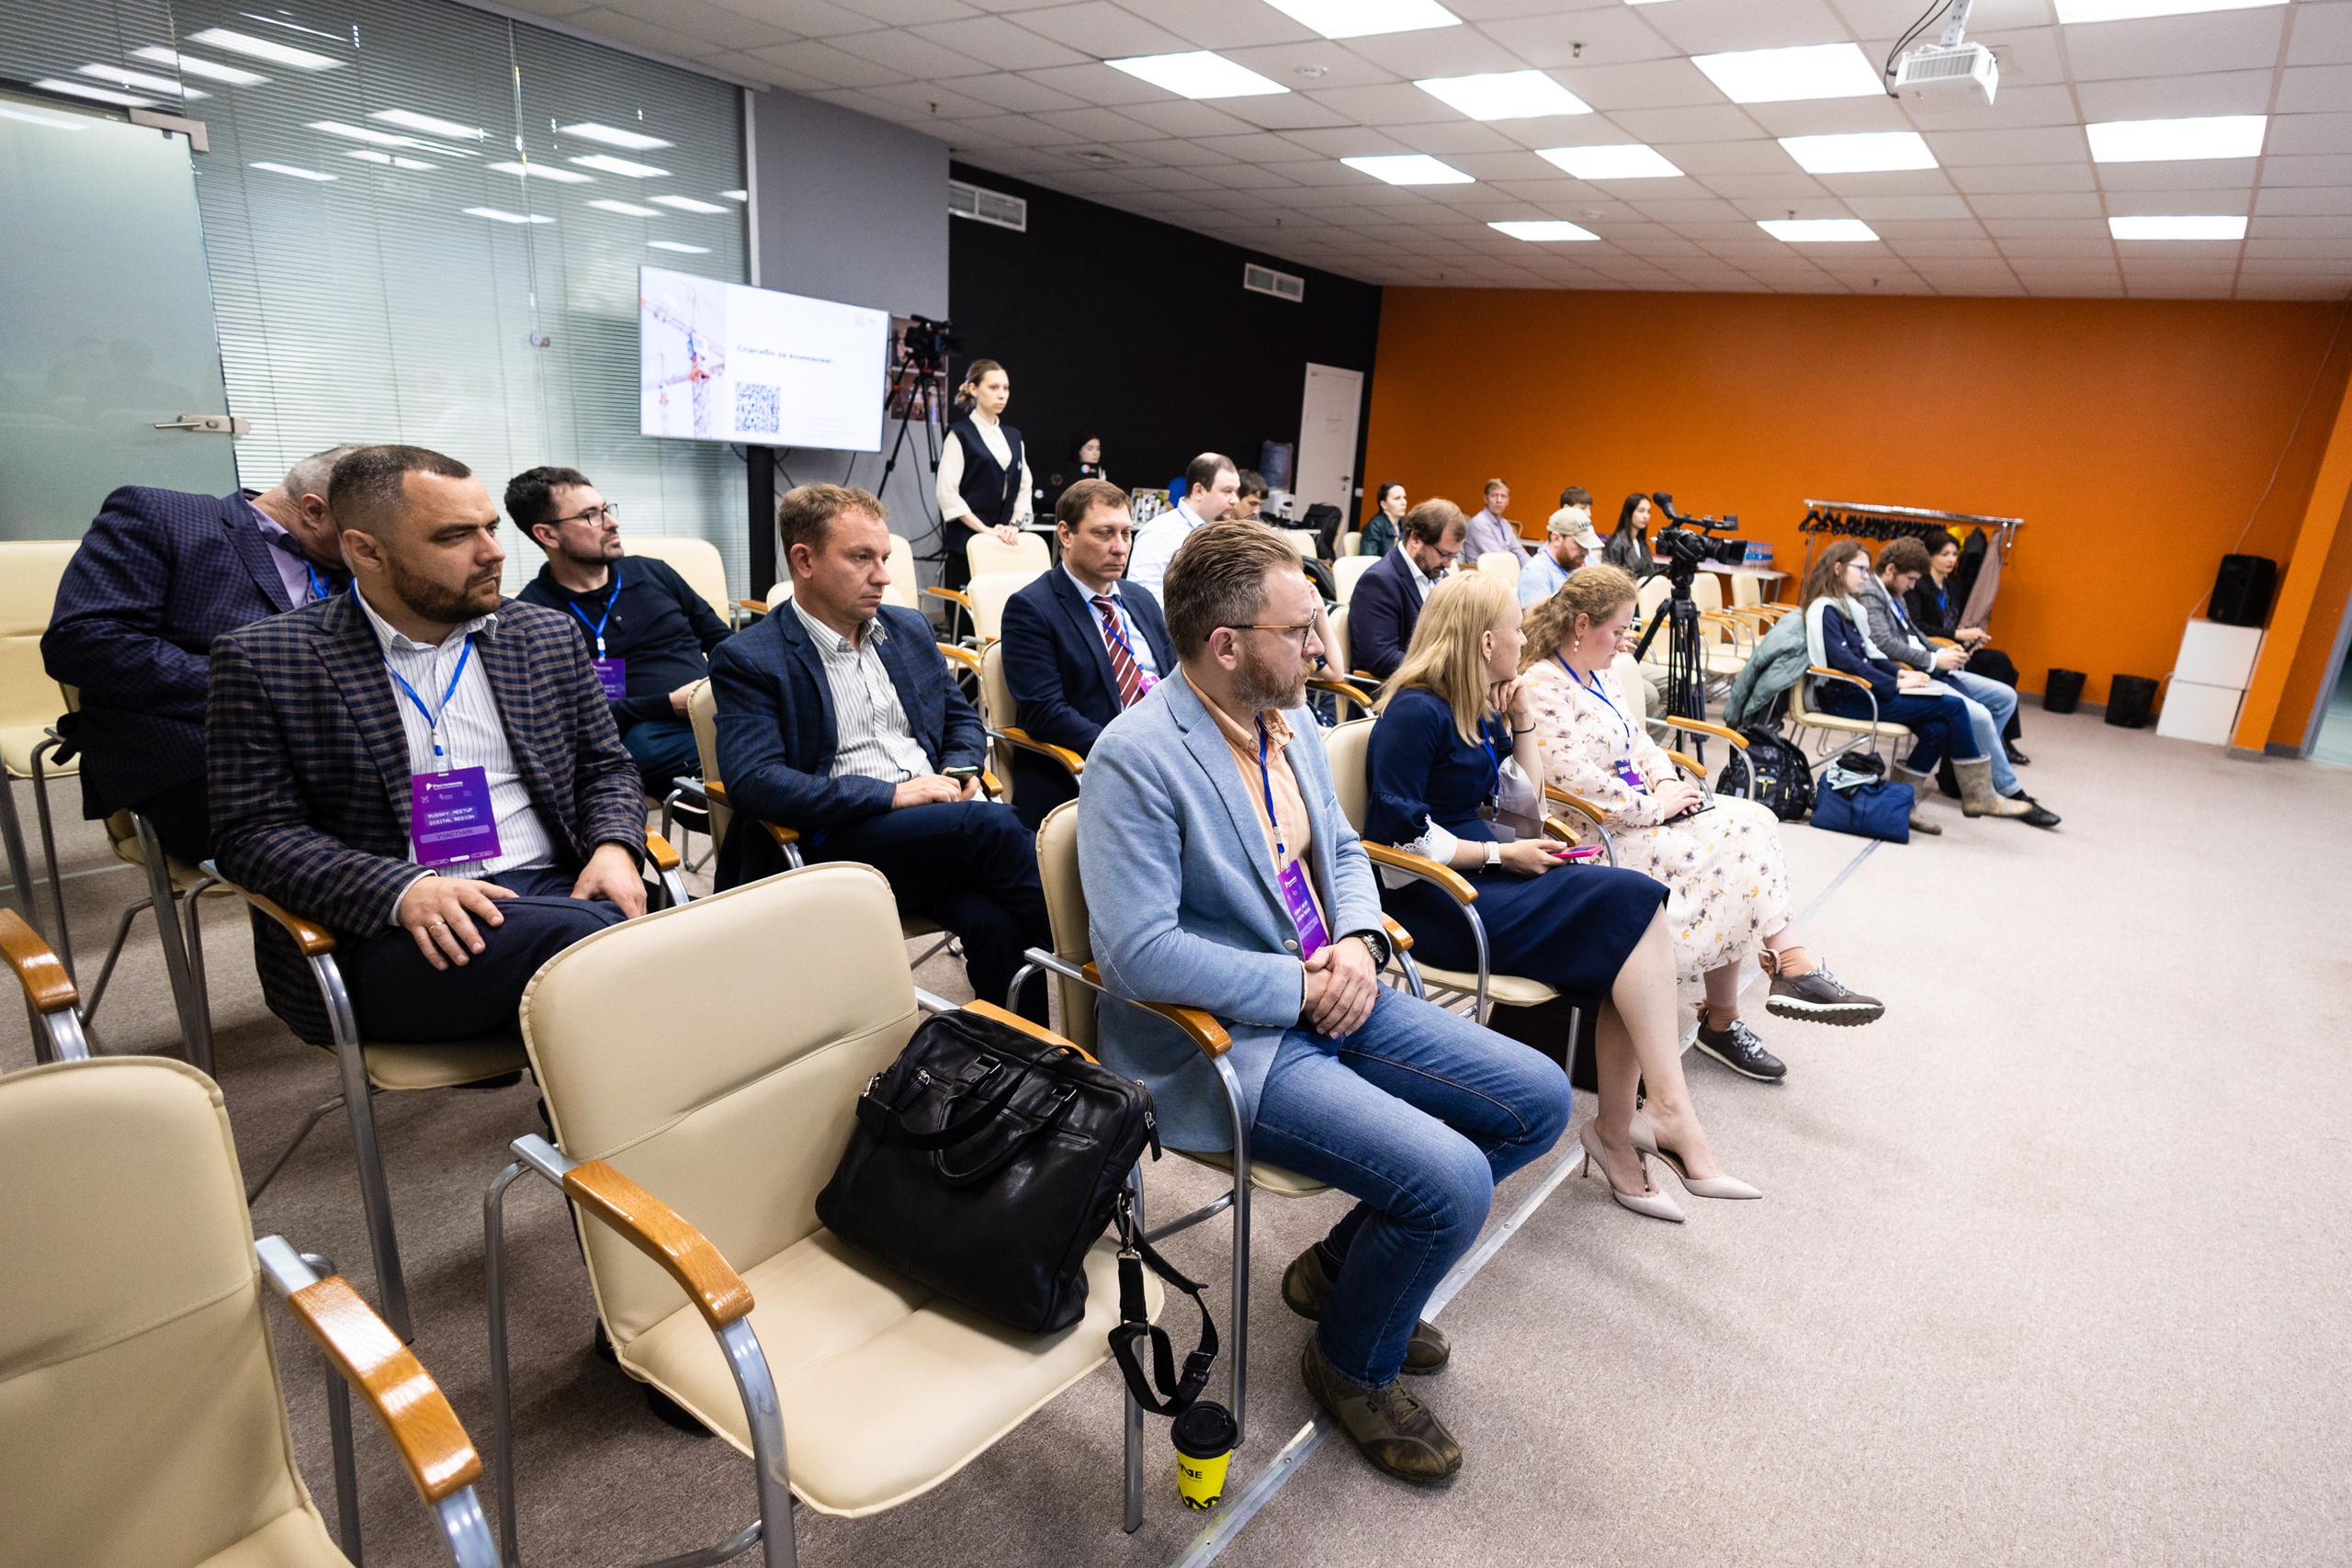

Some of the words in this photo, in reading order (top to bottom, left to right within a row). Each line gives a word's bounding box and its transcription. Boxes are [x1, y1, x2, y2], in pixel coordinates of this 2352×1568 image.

[429, 818, 452, 826] DIGITAL
[454, 814, 475, 822] REGION
[435, 829, 474, 840] УЧАСТНИК
[1178, 1461, 1203, 1479] NE
